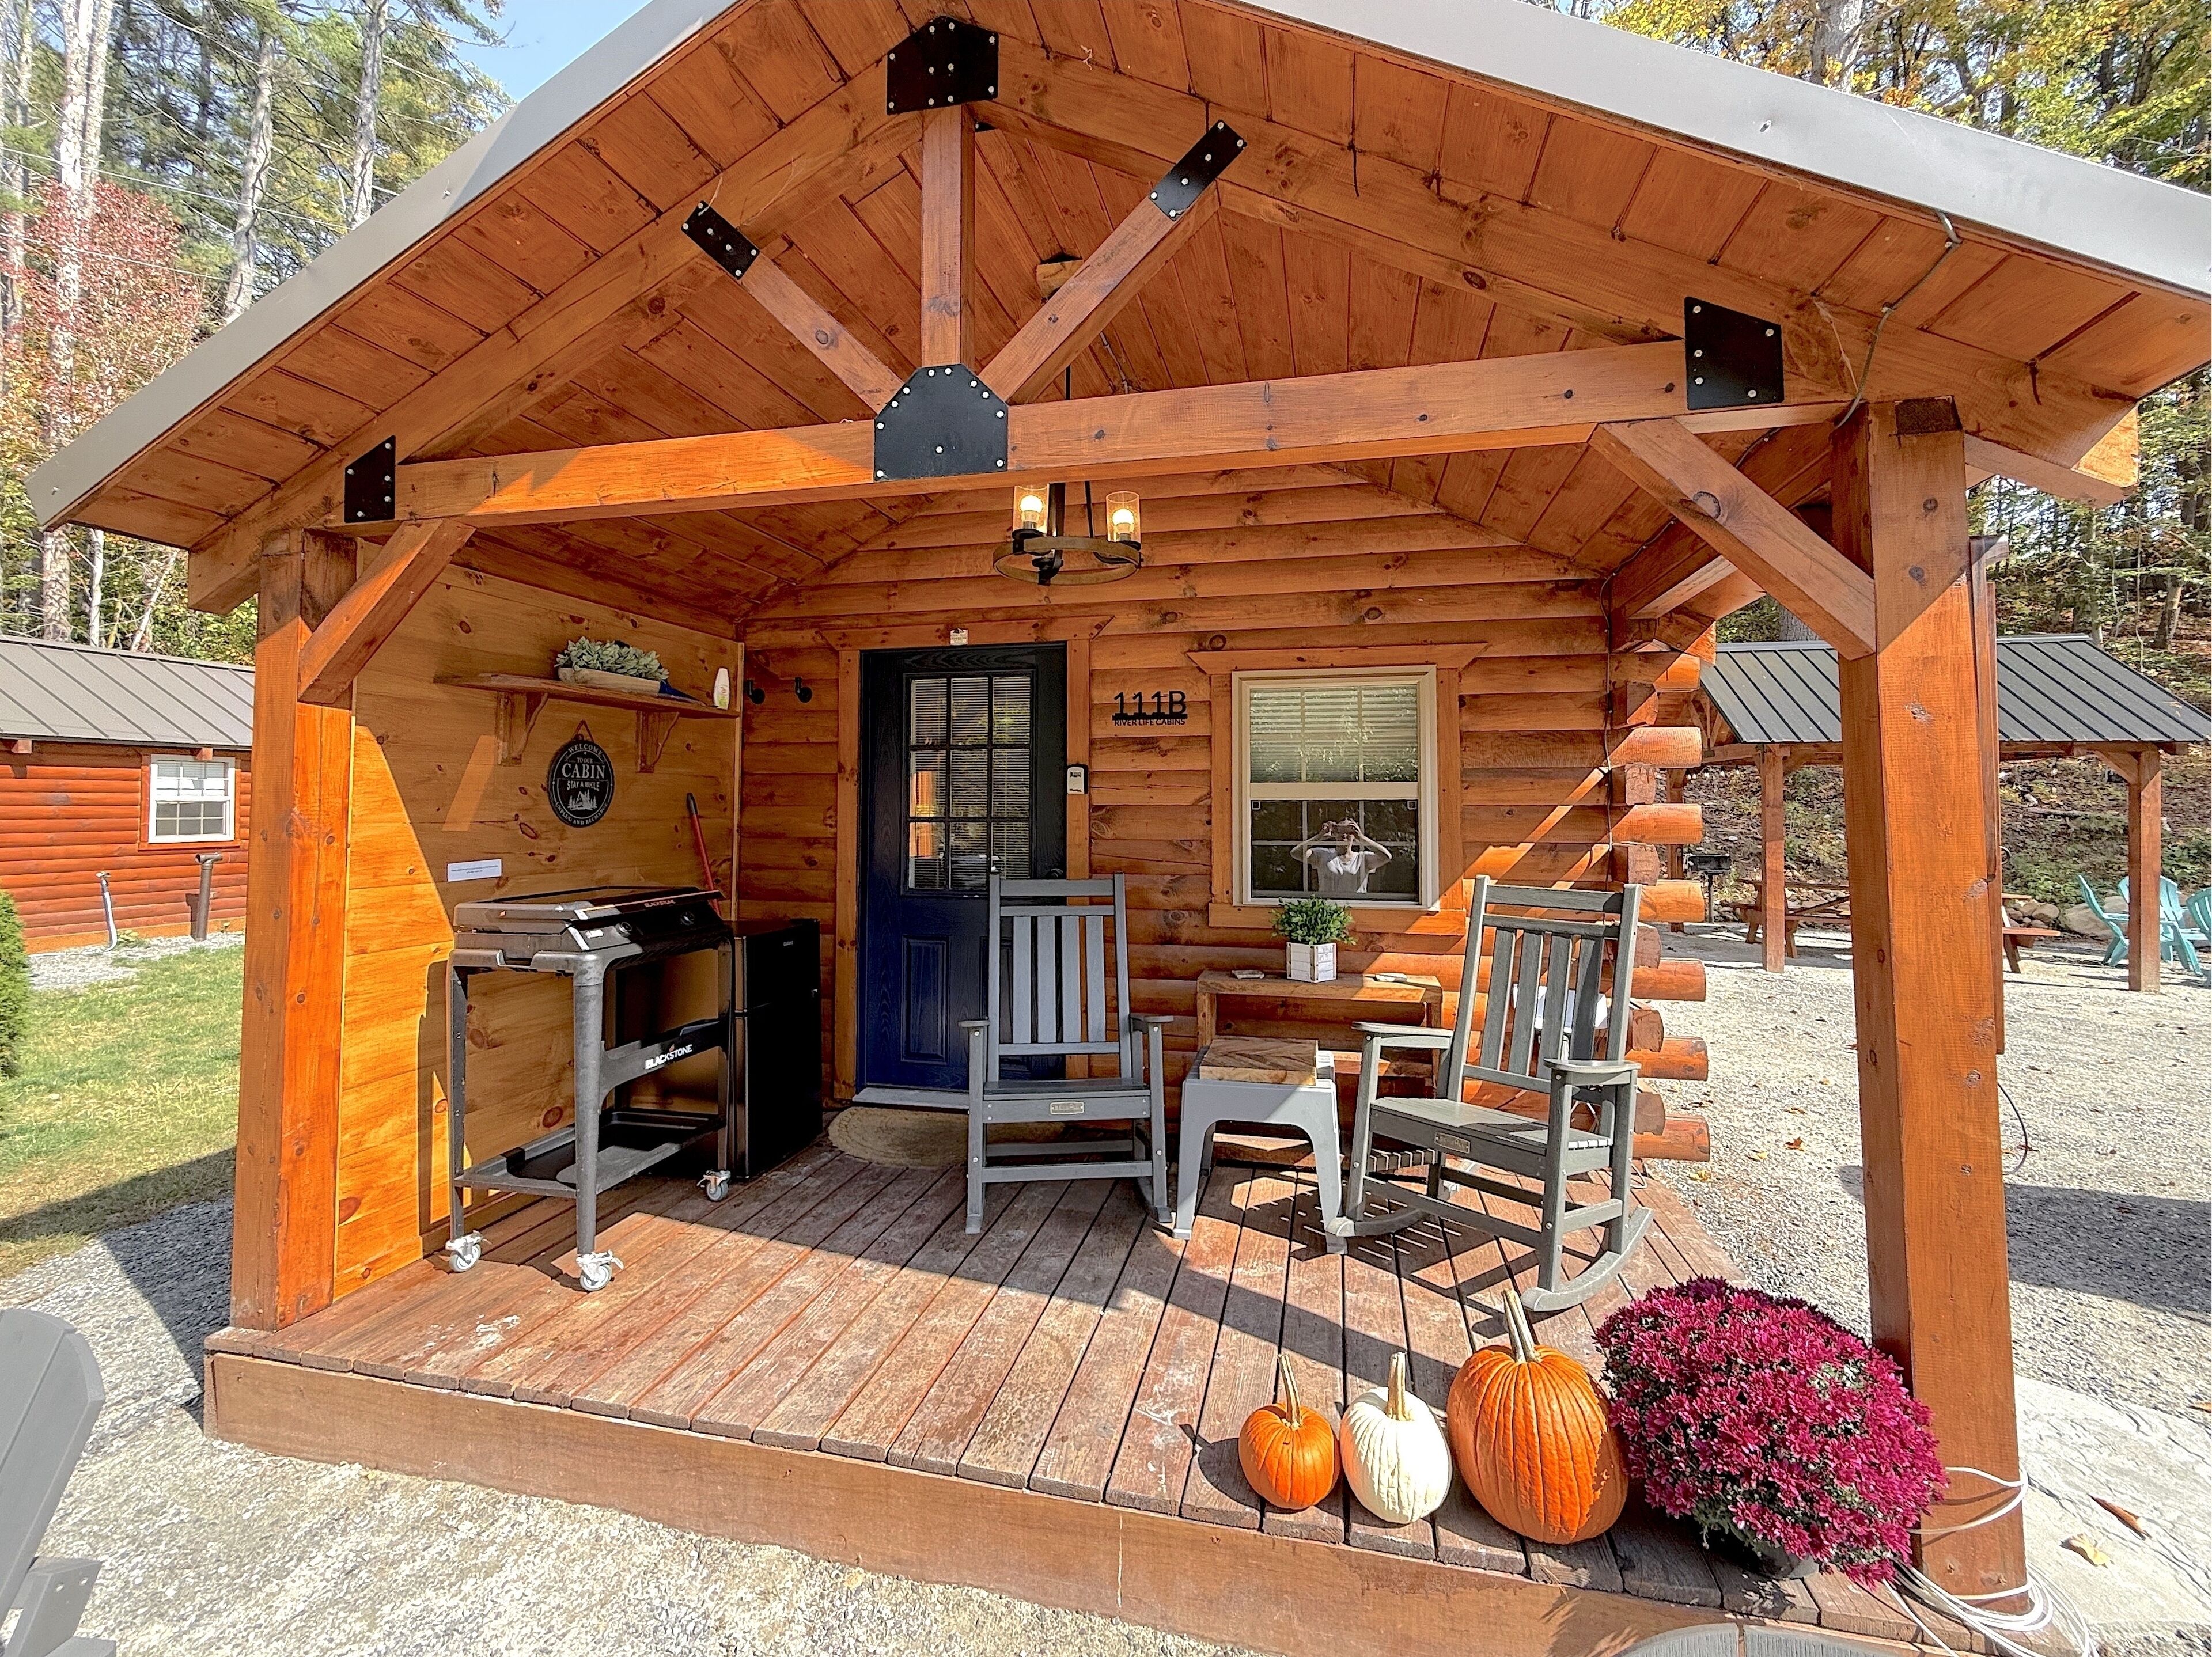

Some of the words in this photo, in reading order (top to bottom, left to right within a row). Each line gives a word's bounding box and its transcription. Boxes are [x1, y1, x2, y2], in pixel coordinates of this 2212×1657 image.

[1113, 691, 1187, 715] 111B
[567, 743, 603, 758] WELCOME
[562, 763, 605, 779] CABIN
[566, 780, 579, 791] STAY
[584, 781, 600, 791] WHILE
[555, 802, 573, 822] UNPLUG
[585, 802, 608, 825] RECHARGE
[644, 899, 676, 908] BLACKSTONE
[645, 1044, 692, 1070] BLACKSTONE
